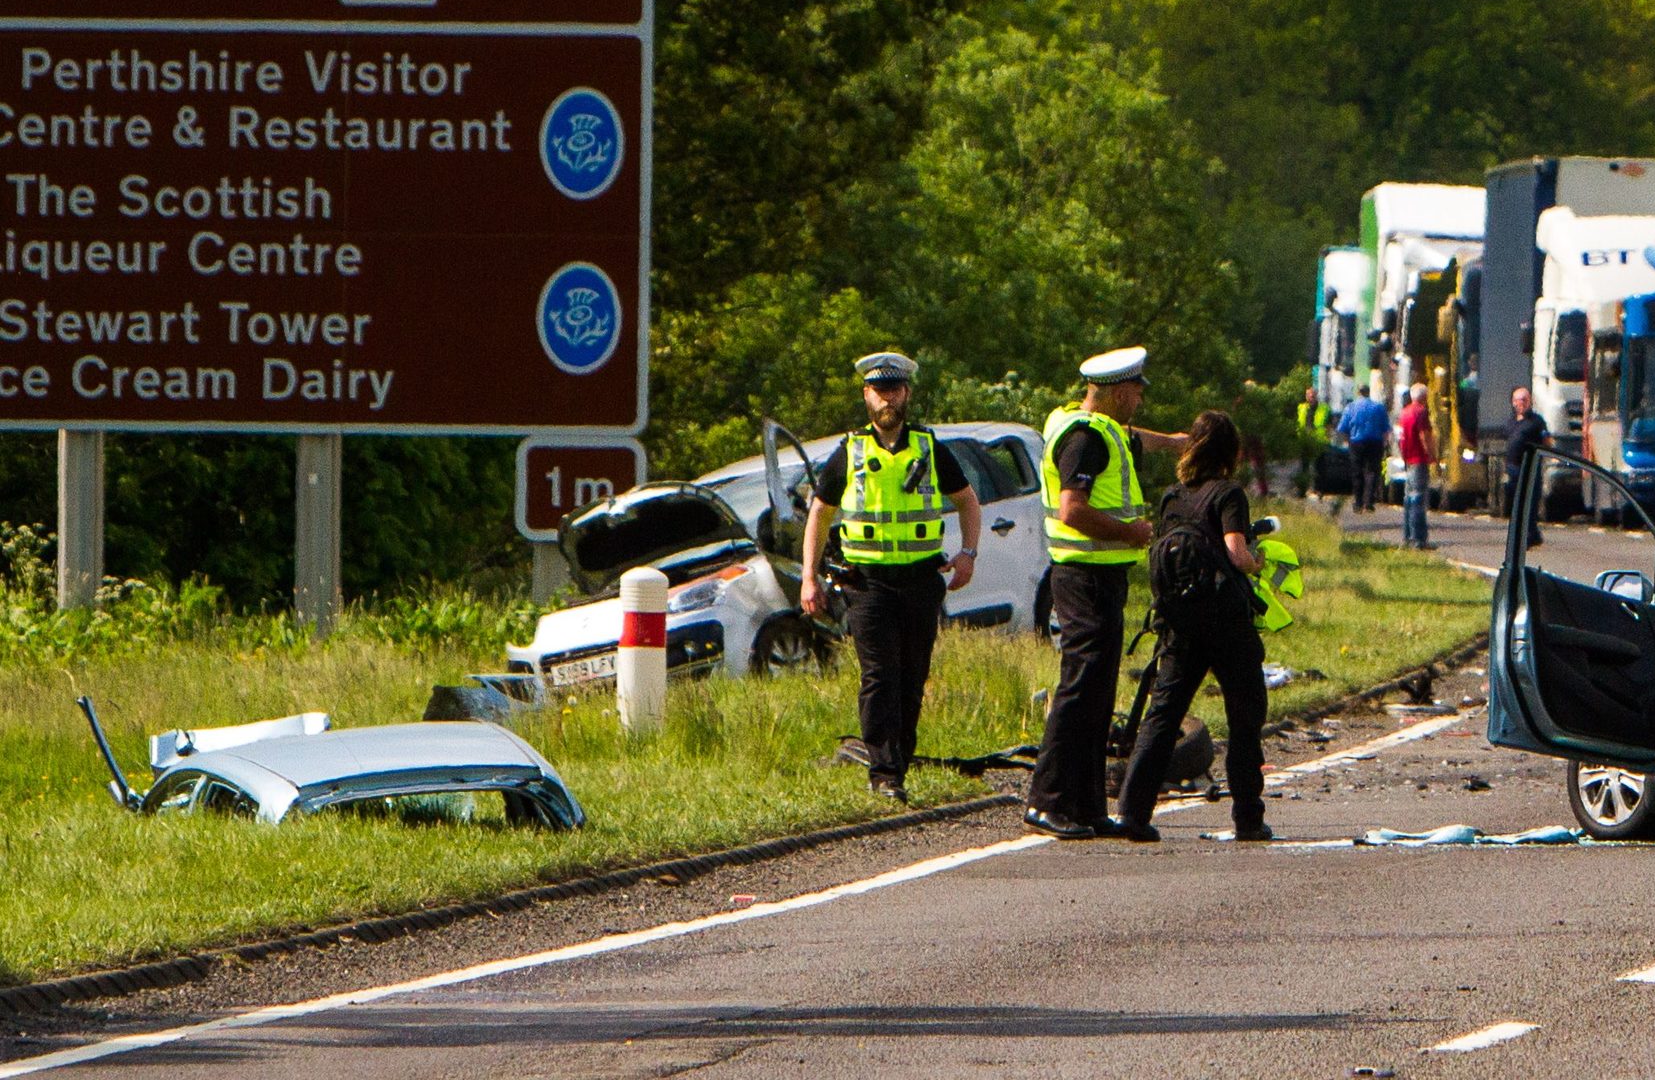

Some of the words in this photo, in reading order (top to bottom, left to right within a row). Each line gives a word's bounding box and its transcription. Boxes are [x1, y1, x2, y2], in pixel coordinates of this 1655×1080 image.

[21, 47, 284, 93] Perthshire
[305, 50, 471, 94] Visitor
[173, 105, 205, 148] &
[228, 106, 512, 151] Restaurant
[6, 173, 97, 217] The
[118, 174, 332, 219] Scottish
[0, 230, 167, 280] iqueur
[188, 231, 363, 276] Centre
[1582, 247, 1637, 266] BT
[0, 298, 201, 344] Stewart
[219, 301, 373, 345] Tower
[72, 354, 237, 400] Cream
[262, 357, 395, 410] Dairy
